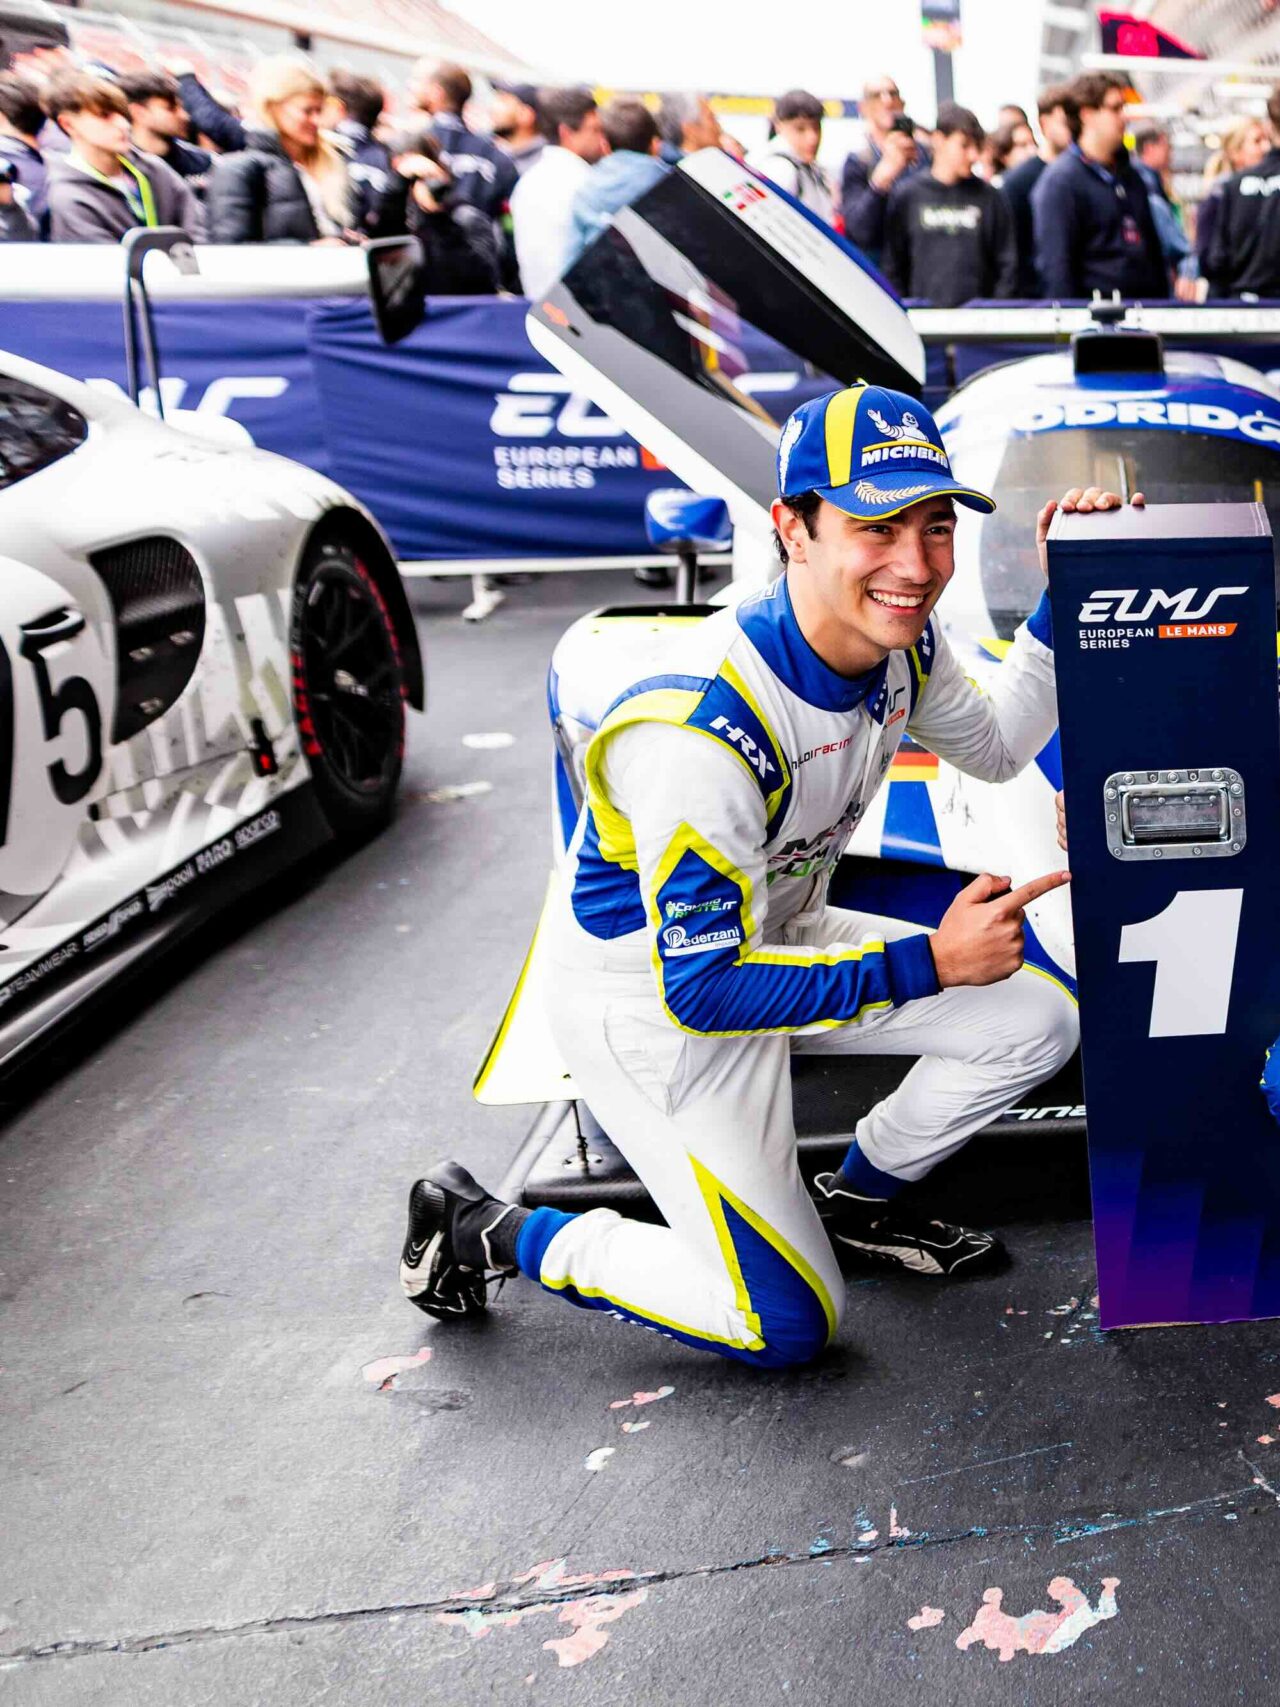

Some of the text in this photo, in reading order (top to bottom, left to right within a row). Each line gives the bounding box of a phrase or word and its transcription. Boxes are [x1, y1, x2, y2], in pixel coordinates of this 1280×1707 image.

[494, 446, 638, 469] EUROPEAN
[860, 445, 949, 470] MICHELIN
[497, 467, 596, 489] SERIES
[1078, 586, 1250, 623] ELMS
[1078, 625, 1228, 640] EUROPEAN LE MANS
[1079, 639, 1131, 650] SERIES
[709, 715, 776, 779] HRX
[663, 925, 740, 948] Pederzani
[1118, 888, 1244, 1038] 1
